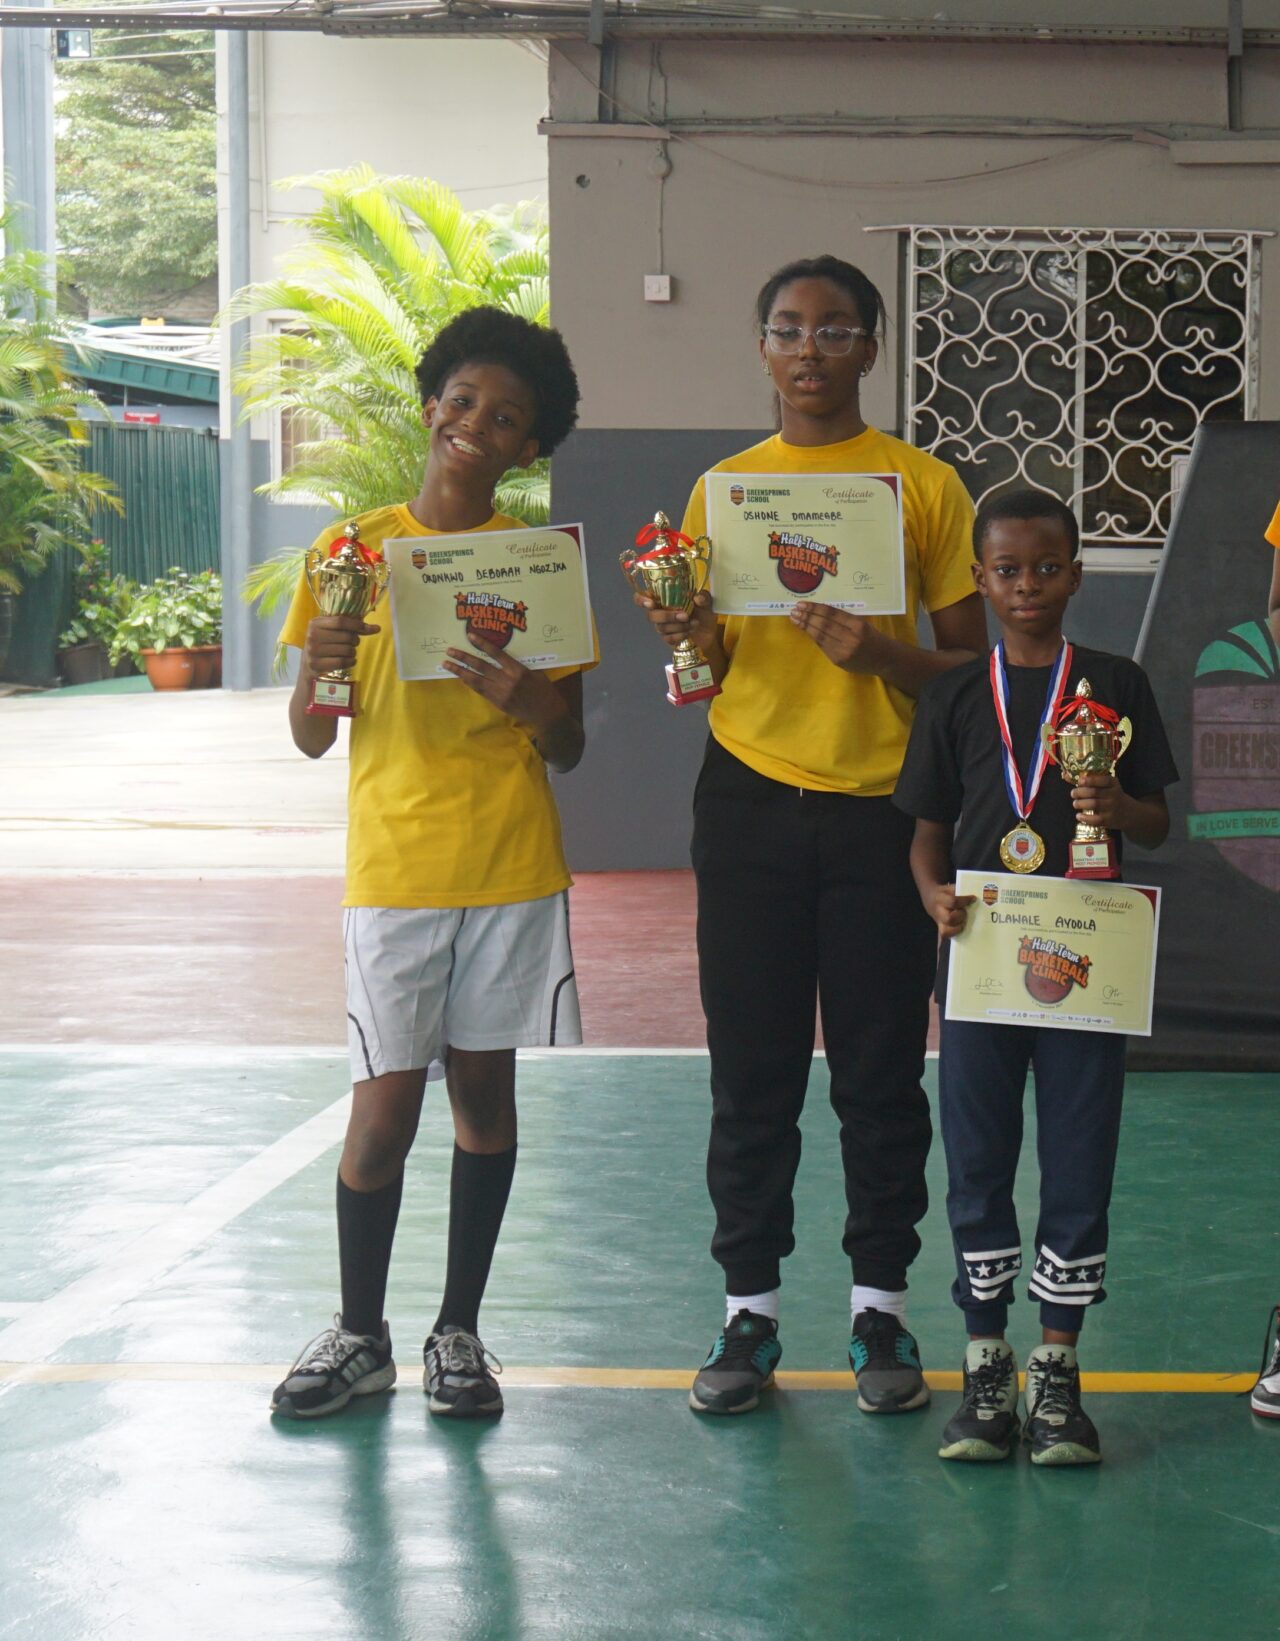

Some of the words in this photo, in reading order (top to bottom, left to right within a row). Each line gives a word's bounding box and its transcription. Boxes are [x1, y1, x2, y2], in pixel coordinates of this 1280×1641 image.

[747, 489, 791, 497] GREENSPRINGS
[823, 488, 875, 502] Certificate
[506, 542, 558, 557] Certificate
[781, 533, 828, 554] Half-Term
[429, 549, 475, 559] GREENSPRINGS
[771, 545, 838, 576] BASKETBALL
[476, 567, 521, 581] DEBORAH
[784, 559, 819, 576] CLINIC
[467, 592, 515, 611] Half-Term
[457, 605, 527, 632] BASKETBALL
[471, 618, 508, 634] CLINIC
[1210, 819, 1239, 831] LOVE
[1243, 817, 1279, 829] SERVE
[1001, 890, 1049, 900] GREENSPRINGS
[1082, 895, 1135, 910] Certificate
[991, 912, 1041, 927] OLAWALE
[1056, 916, 1097, 931] AYOOLA
[1032, 938, 1080, 963] Half-Term
[1019, 950, 1089, 988] BASKETBALL
[1032, 965, 1070, 986] CLINIC
